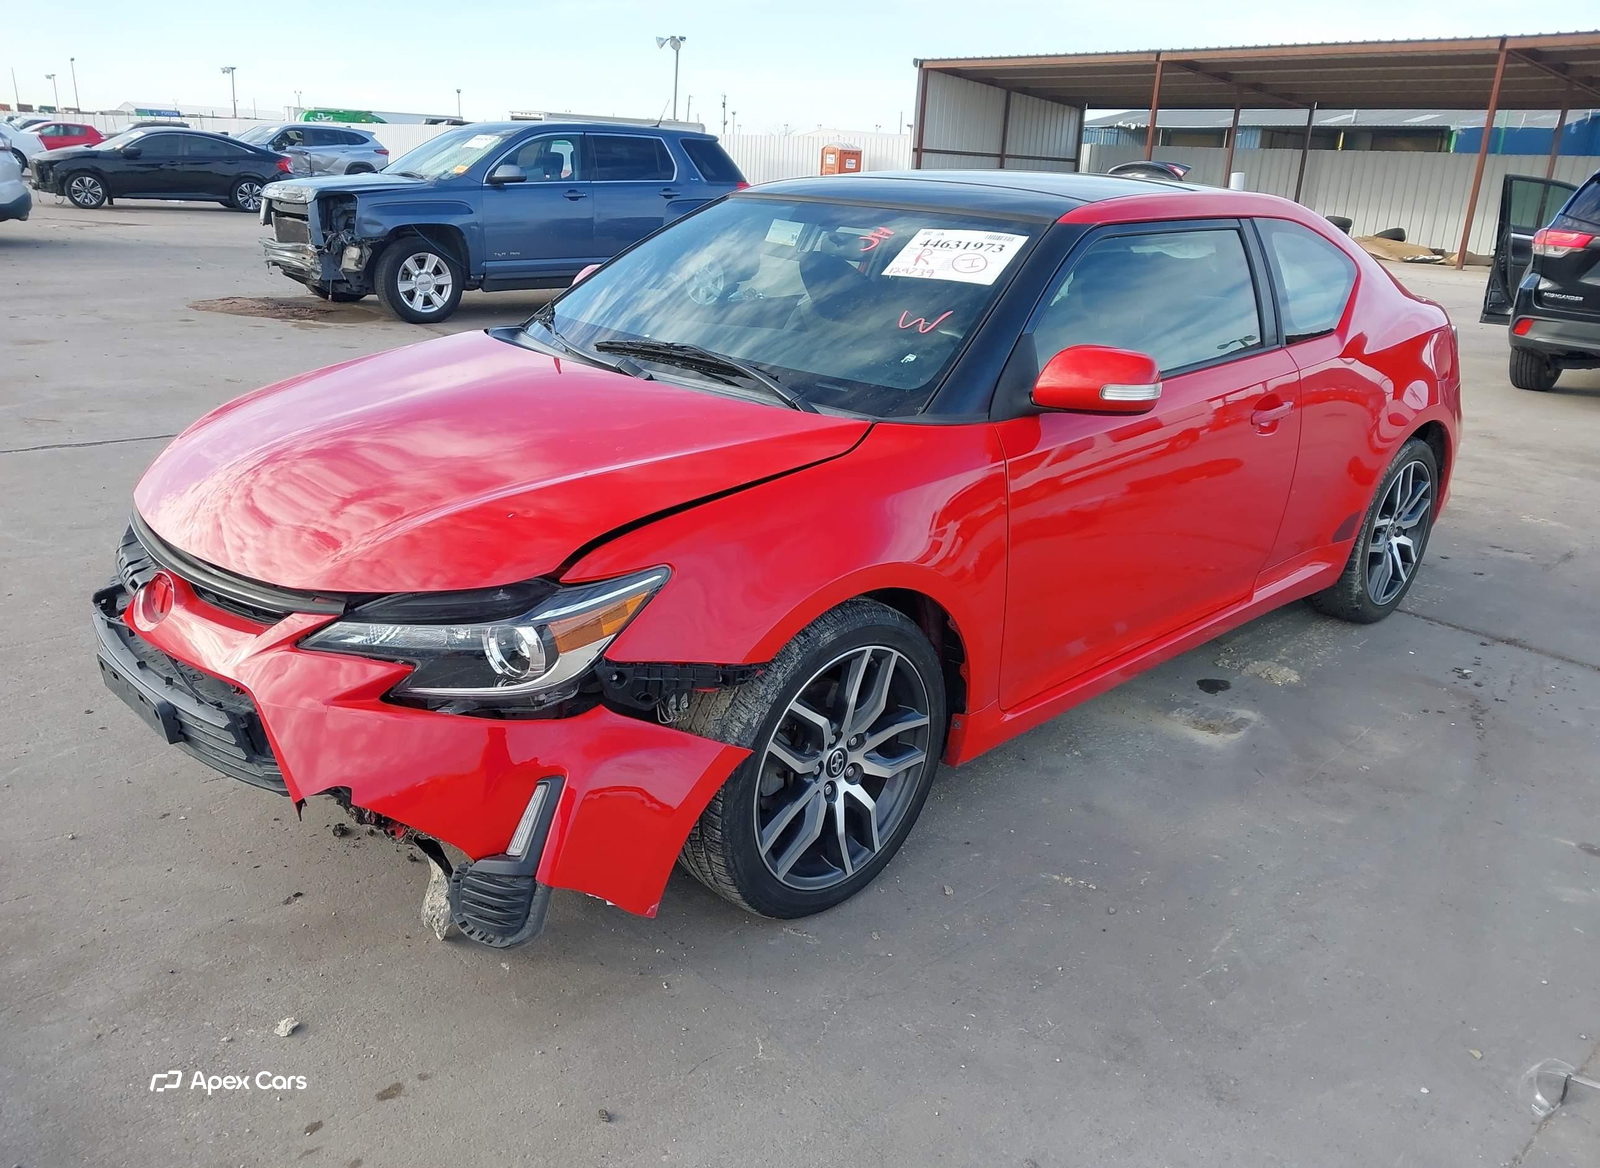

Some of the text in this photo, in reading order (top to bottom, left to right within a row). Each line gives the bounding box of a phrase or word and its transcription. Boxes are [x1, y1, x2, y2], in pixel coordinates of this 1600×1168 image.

[919, 238, 1006, 254] 44631973
[913, 248, 934, 266] R
[898, 310, 954, 333] W
